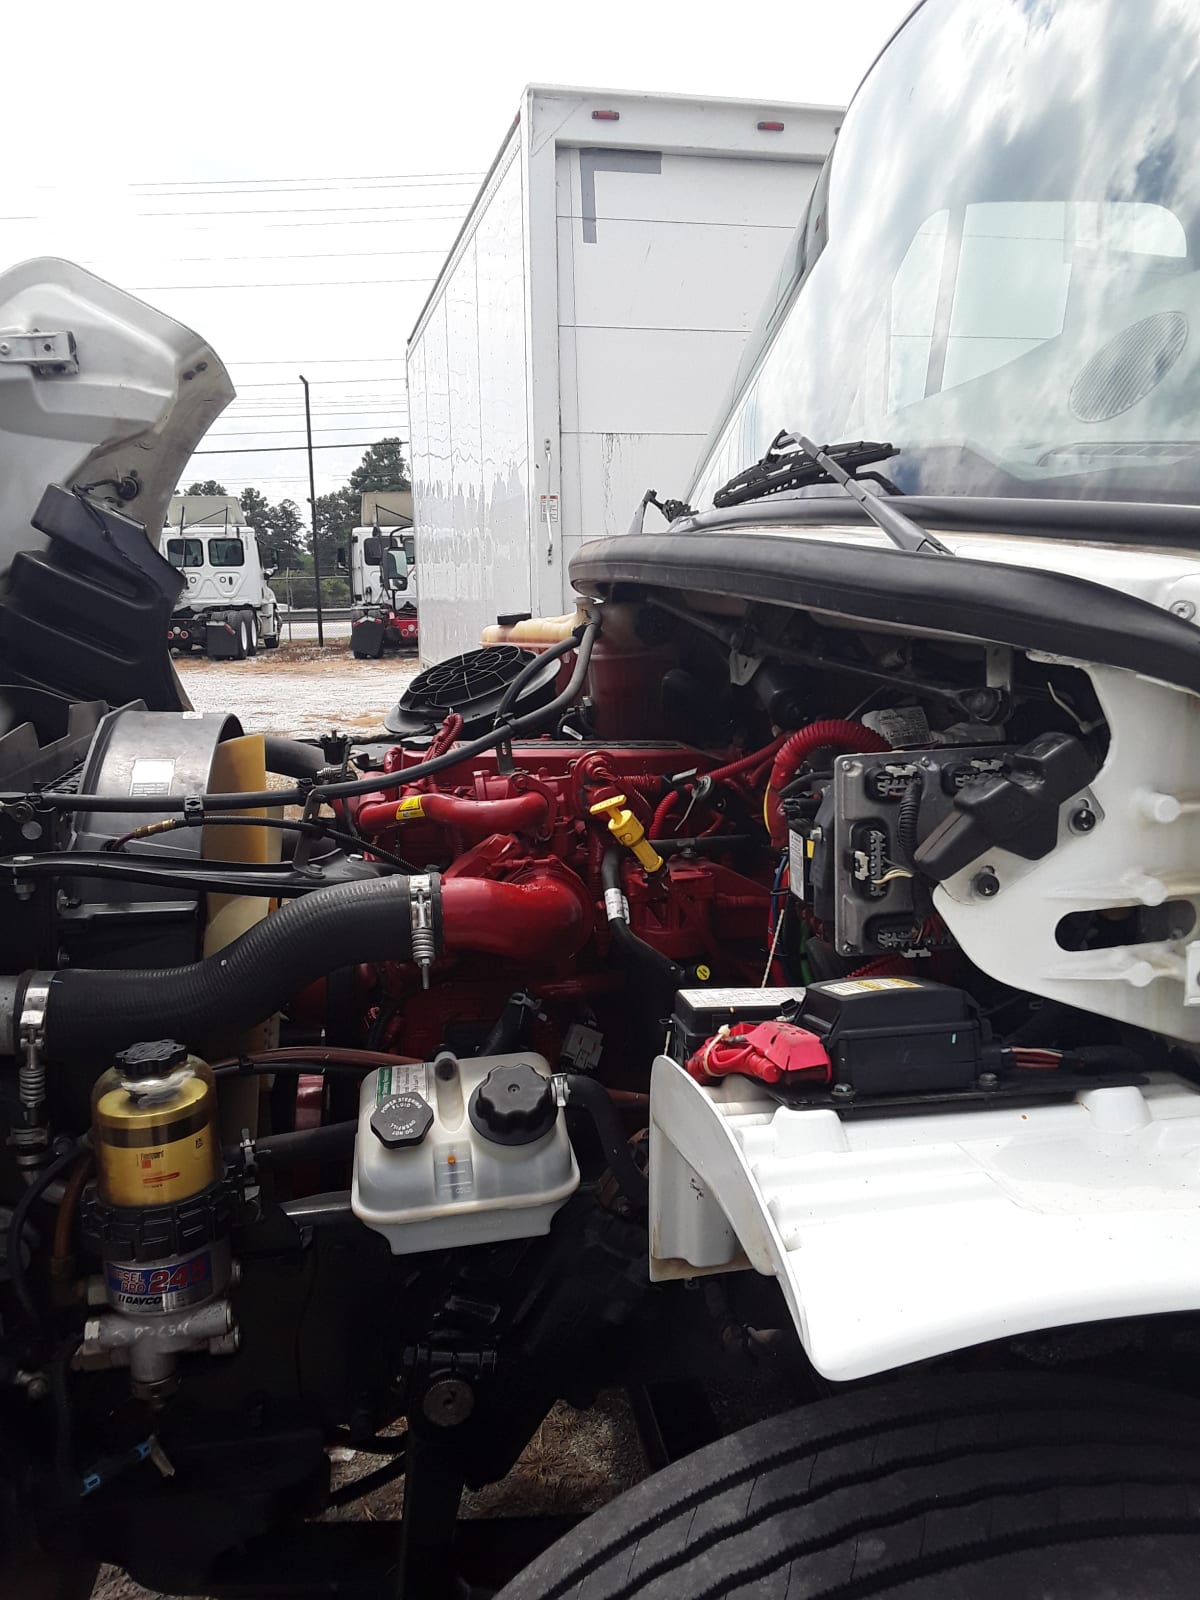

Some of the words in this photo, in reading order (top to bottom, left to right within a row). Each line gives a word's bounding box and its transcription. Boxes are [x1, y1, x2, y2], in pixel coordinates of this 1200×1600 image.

[381, 1099, 397, 1114] POWER
[398, 1097, 423, 1109] STEERING
[392, 1102, 411, 1110] FLUID
[390, 1119, 416, 1131] OVERFILL
[149, 1259, 206, 1294] 245
[121, 1281, 147, 1294] PRO
